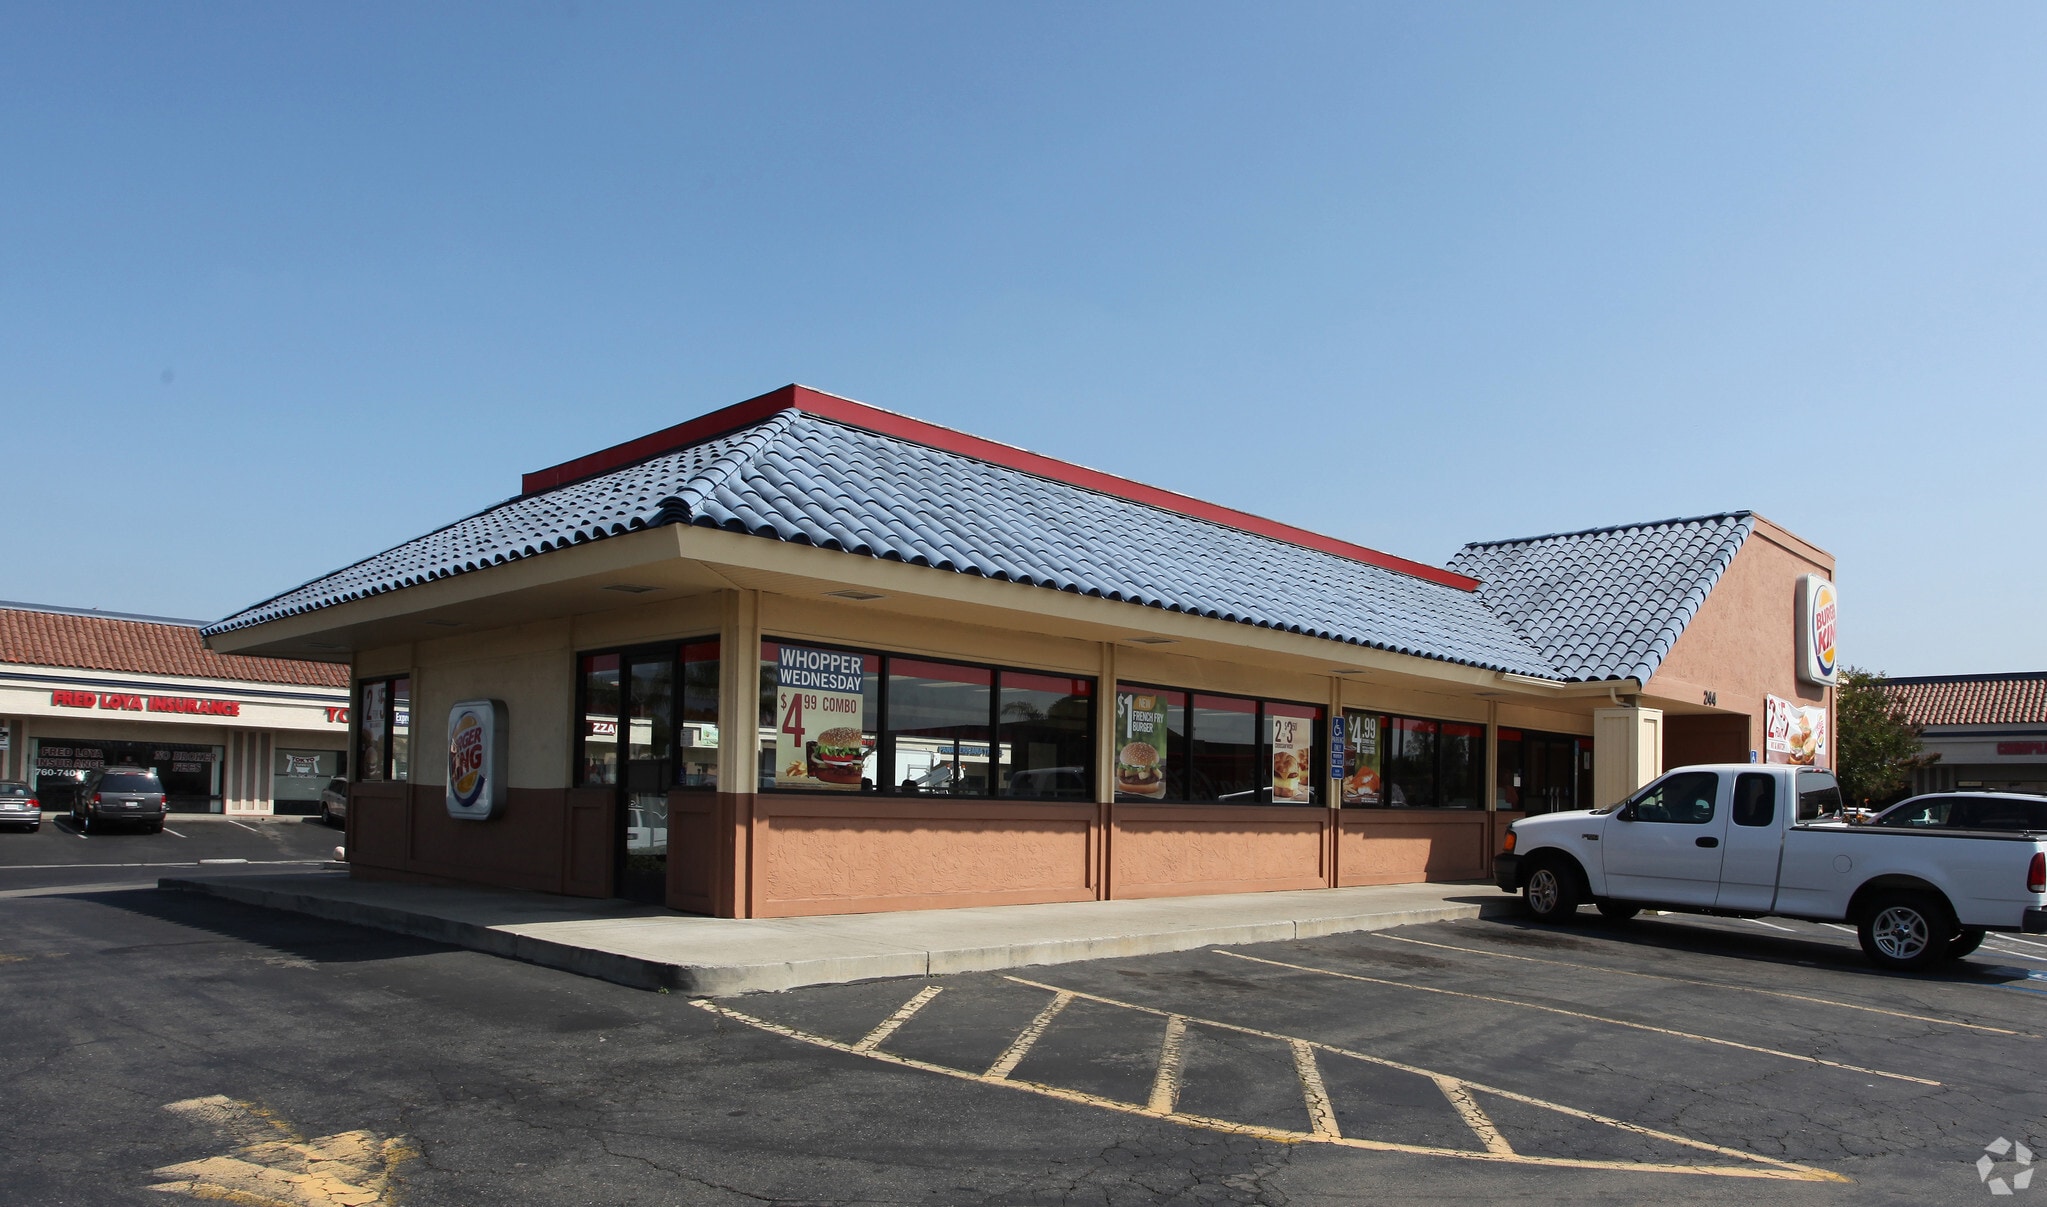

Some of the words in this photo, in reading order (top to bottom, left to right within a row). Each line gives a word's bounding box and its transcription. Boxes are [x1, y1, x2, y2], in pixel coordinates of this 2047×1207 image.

[780, 648, 861, 675] WHOPPER
[780, 669, 861, 691] WEDNESDAY
[52, 690, 97, 708] FRED
[100, 692, 143, 712] LOYA
[147, 696, 240, 717] INSURANCE
[822, 697, 857, 714] COMBO
[1703, 690, 1716, 707] 244
[1117, 693, 1133, 739] $1
[1132, 710, 1153, 722] FRENCH
[1154, 712, 1164, 724] FRY
[1132, 721, 1153, 733] BURGER
[1768, 699, 1776, 738] 2
[1275, 720, 1281, 742] 2
[1348, 714, 1376, 754] $4.99
[37, 758, 104, 769] INSURANCE
[41, 747, 73, 757] FRED
[75, 748, 104, 759] LOYA
